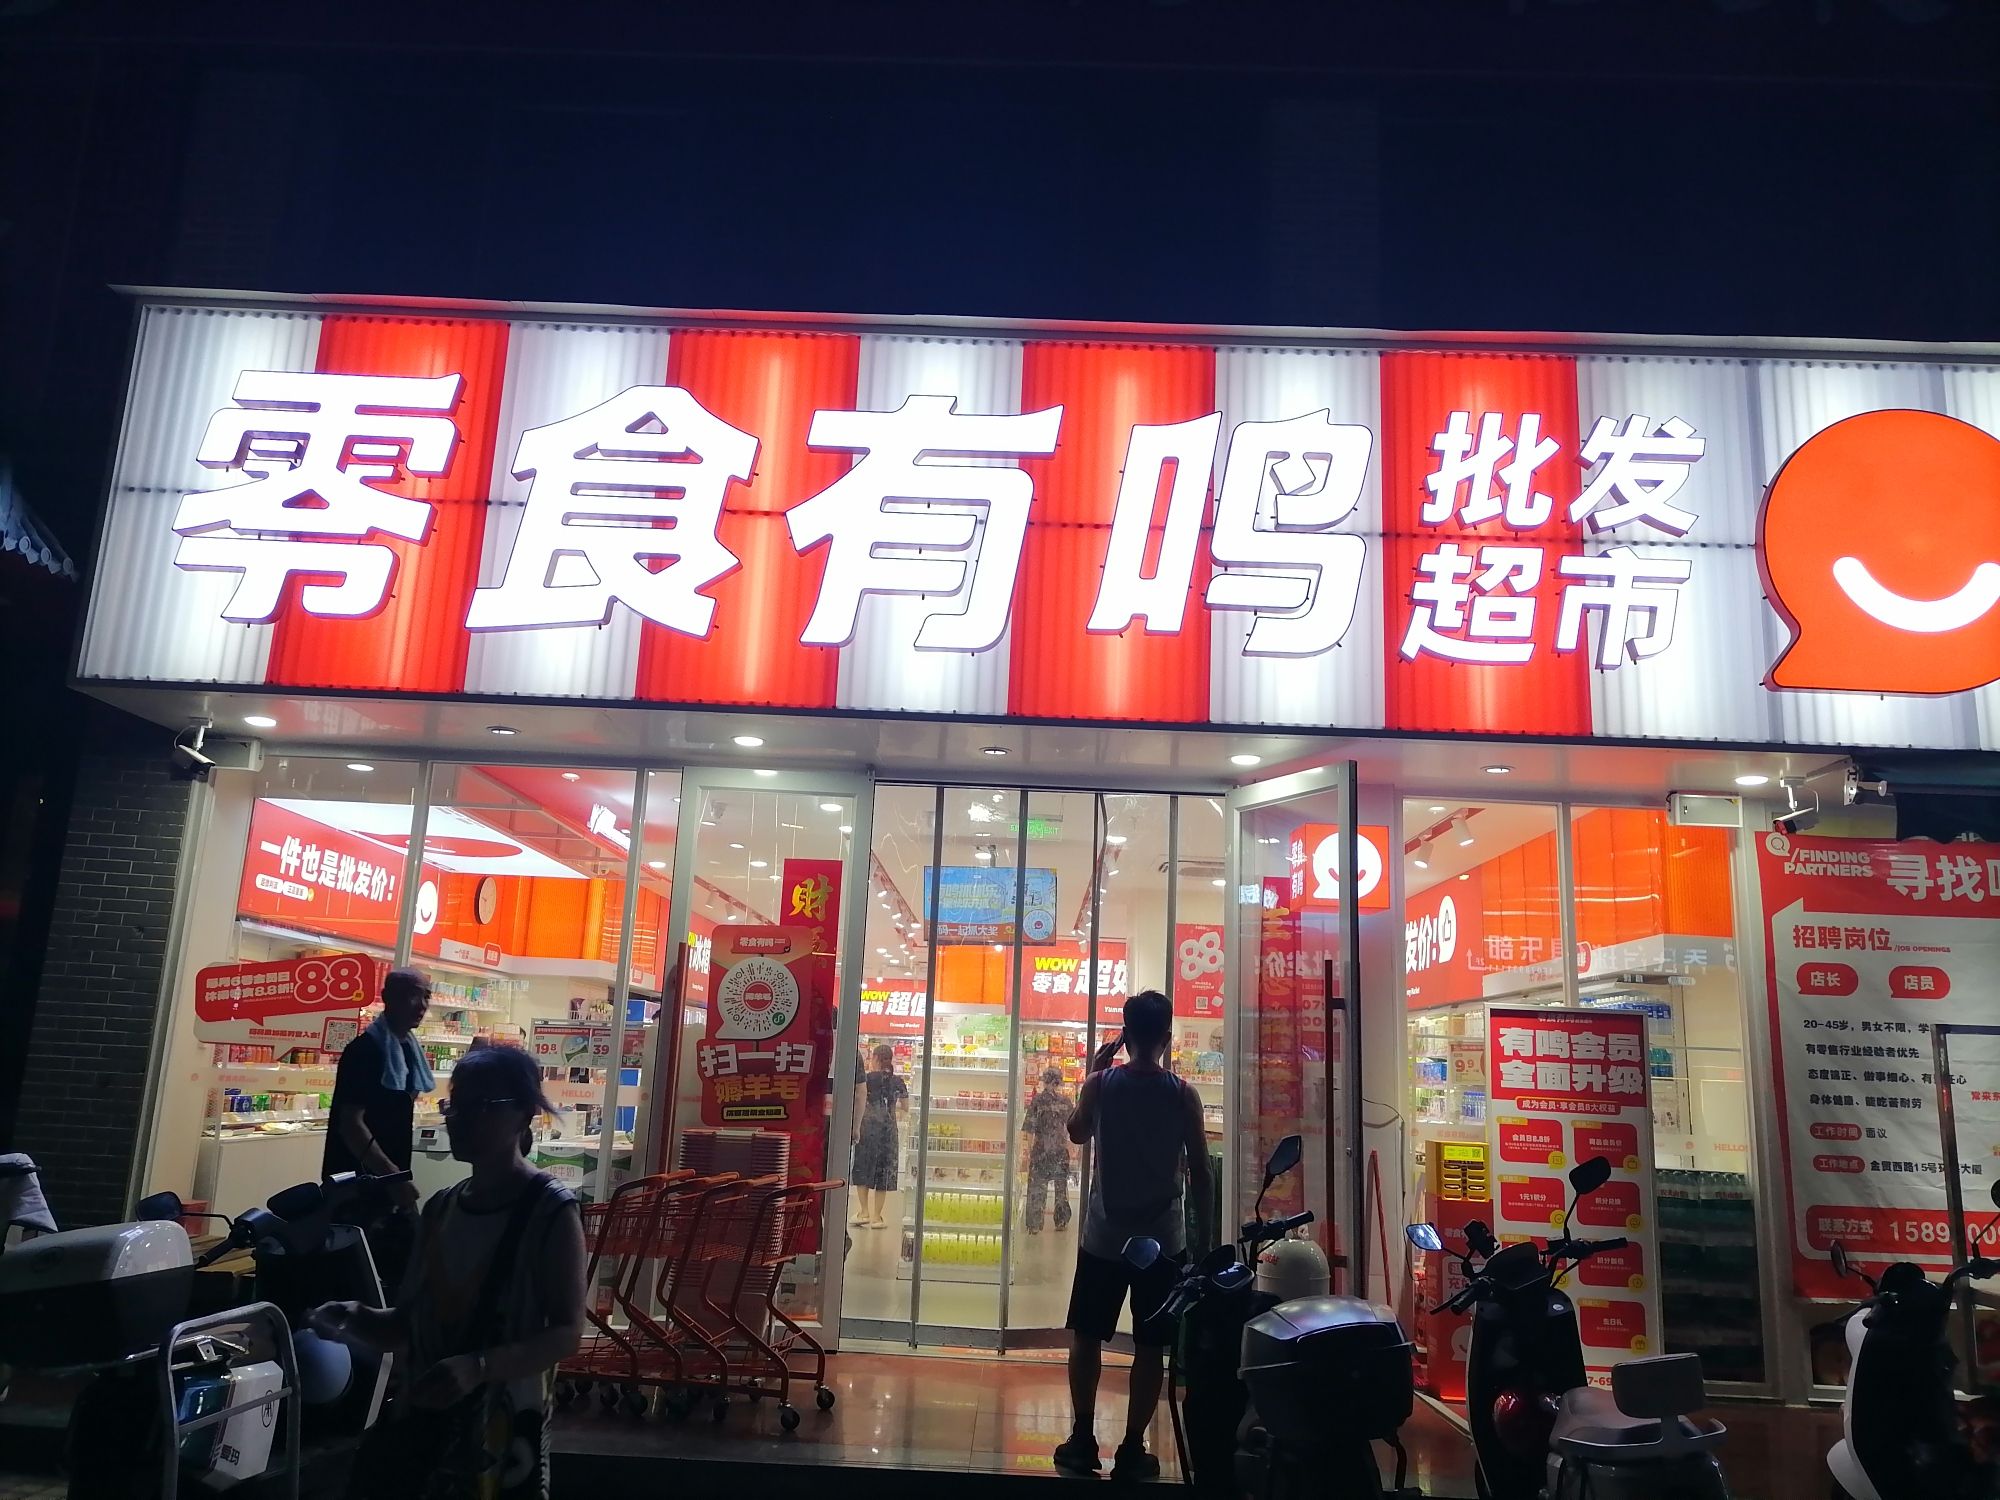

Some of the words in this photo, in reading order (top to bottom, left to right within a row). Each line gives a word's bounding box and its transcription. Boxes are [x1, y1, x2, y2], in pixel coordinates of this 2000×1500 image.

[1420, 410, 1708, 537] 批发
[172, 369, 1375, 658] 零食有鸣
[1399, 544, 1693, 671] 超市
[260, 835, 396, 902] 一件也是批发价!
[1784, 861, 1873, 878] PARTNERS
[789, 873, 834, 921] 财
[936, 924, 998, 937] 码一起抓大奖
[1792, 924, 1892, 951] 招聘岗位
[1034, 956, 1079, 973] WOW
[294, 957, 364, 1004] 88
[1032, 971, 1072, 994] 零食
[1810, 971, 1841, 988] 店长
[1903, 974, 1936, 991] 店员
[861, 990, 890, 1002] WOW
[1498, 1027, 1642, 1062] 有鸣会员
[1806, 1043, 1920, 1059] 有零售行业经验者优先
[701, 1041, 813, 1077] 扫一扫
[1499, 1059, 1644, 1094] 全面升级
[1807, 1068, 1967, 1085] 态度端正、做事细心、有任心
[561, 1088, 594, 1098] HELLO!
[714, 1073, 800, 1104] 薅羊毛
[1809, 1093, 1922, 1109] 身体健康、能吃苦耐劳
[1814, 1125, 1859, 1138] 工作时间
[1865, 1127, 1888, 1139] 面议
[1819, 1158, 1859, 1170] 工作地点
[1870, 1160, 1983, 1175] 金贸西路15号环大厦
[1818, 1218, 1874, 1234] 联系方式
[1889, 1220, 2000, 1246] 158900
